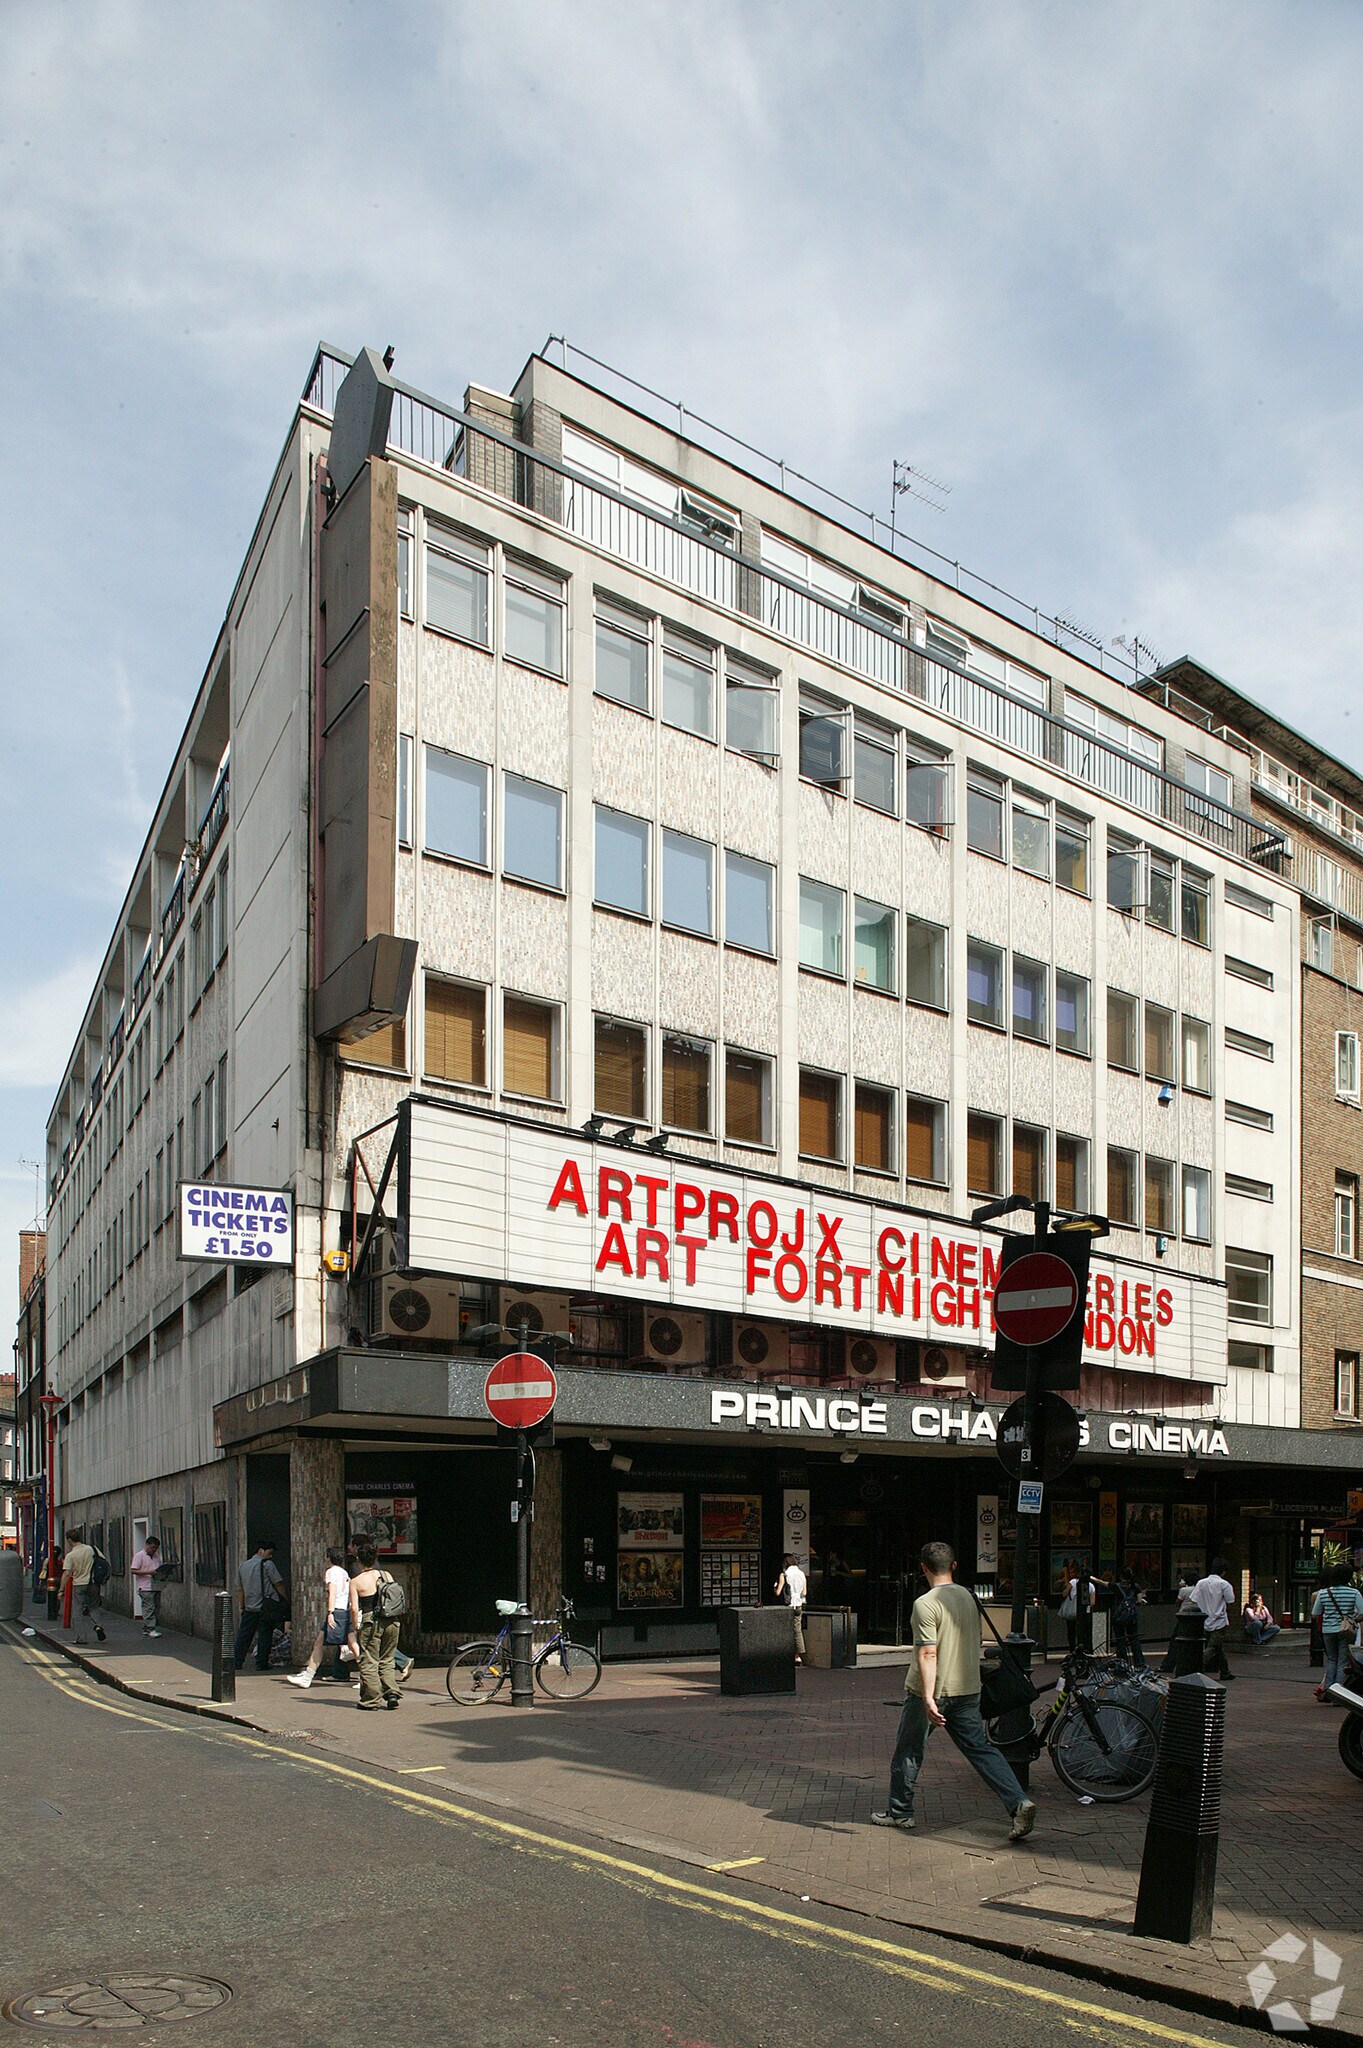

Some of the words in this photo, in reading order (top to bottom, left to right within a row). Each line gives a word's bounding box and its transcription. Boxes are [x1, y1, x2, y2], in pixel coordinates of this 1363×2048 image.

[187, 1188, 289, 1214] CINEMA
[188, 1209, 288, 1234] TICKETS
[547, 1158, 844, 1262] ARTPROJX
[878, 1226, 1002, 1291] CINEM
[204, 1236, 273, 1258] £1.50
[596, 1222, 708, 1286] ART
[710, 1390, 888, 1434] PRINCE
[1108, 1421, 1230, 1456] CINEMA
[1022, 1450, 1028, 1460] 3
[392, 1482, 415, 1490] CINEMA
[1022, 1489, 1041, 1498] CCTV
[1281, 1504, 1319, 1513] LEICESTER
[1320, 1505, 1344, 1514] PLACE
